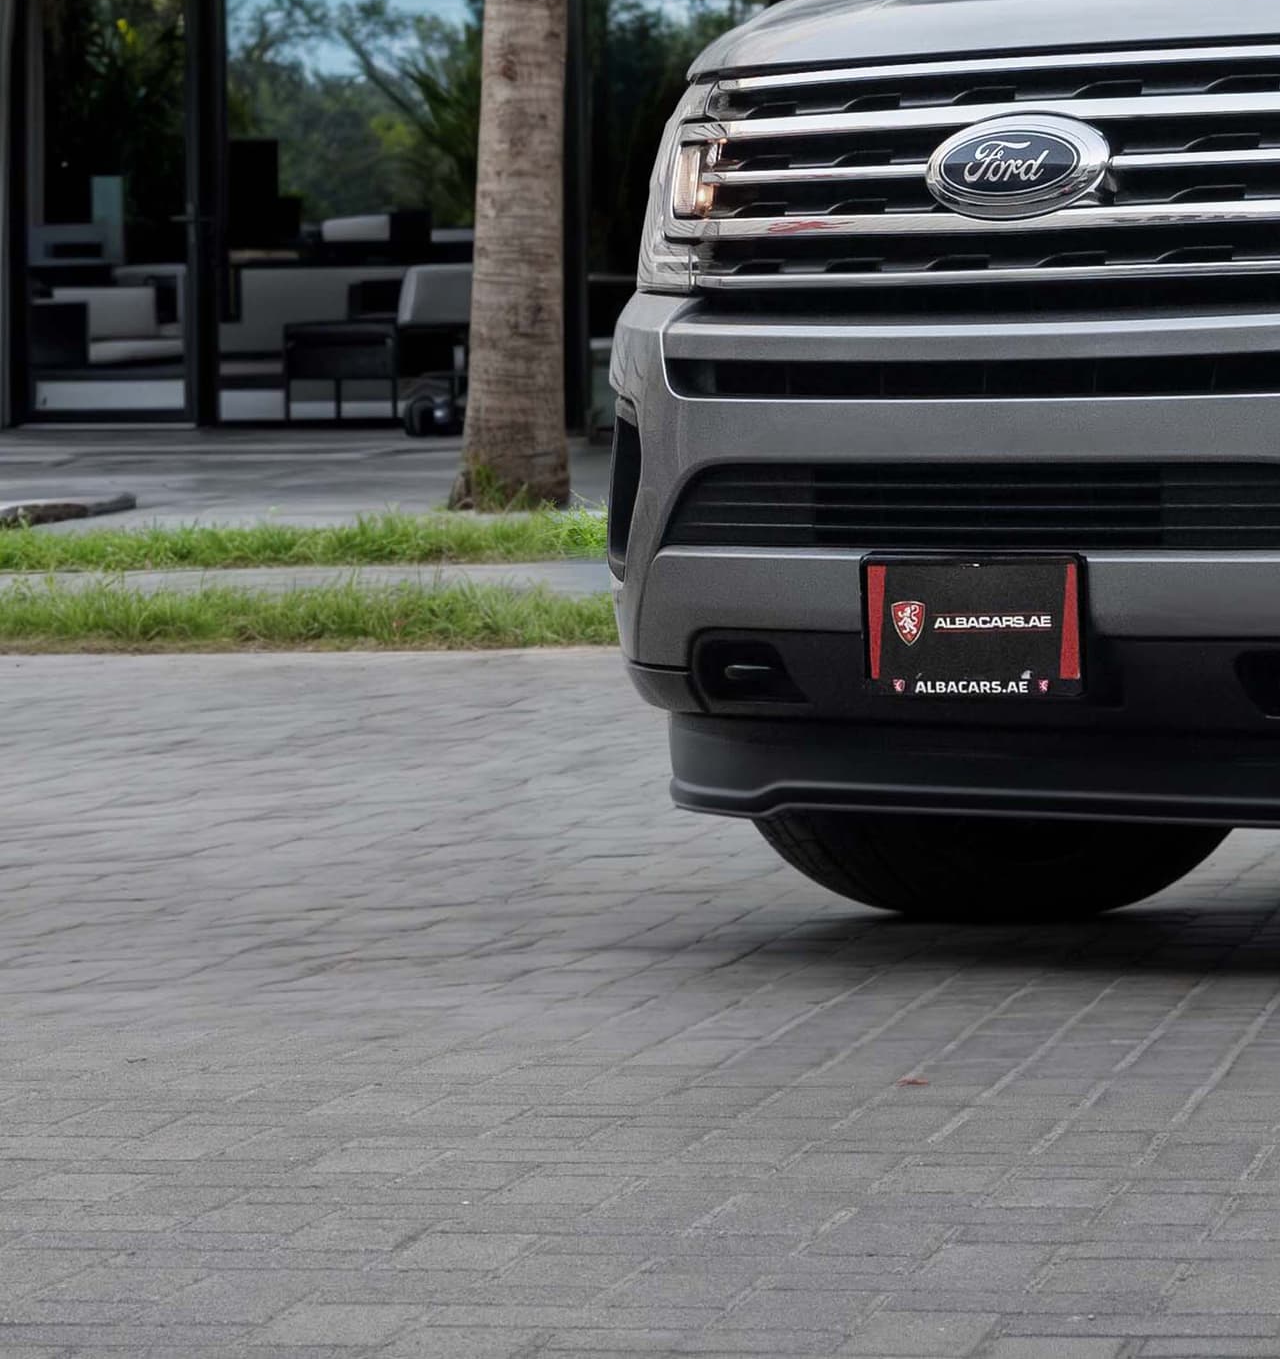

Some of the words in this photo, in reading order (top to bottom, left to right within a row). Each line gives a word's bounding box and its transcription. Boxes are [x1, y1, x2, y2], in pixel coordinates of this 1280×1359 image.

[963, 140, 1050, 183] Ford
[934, 616, 1052, 629] ALBACARS.AE
[915, 681, 1029, 693] ALBACARS.AE
